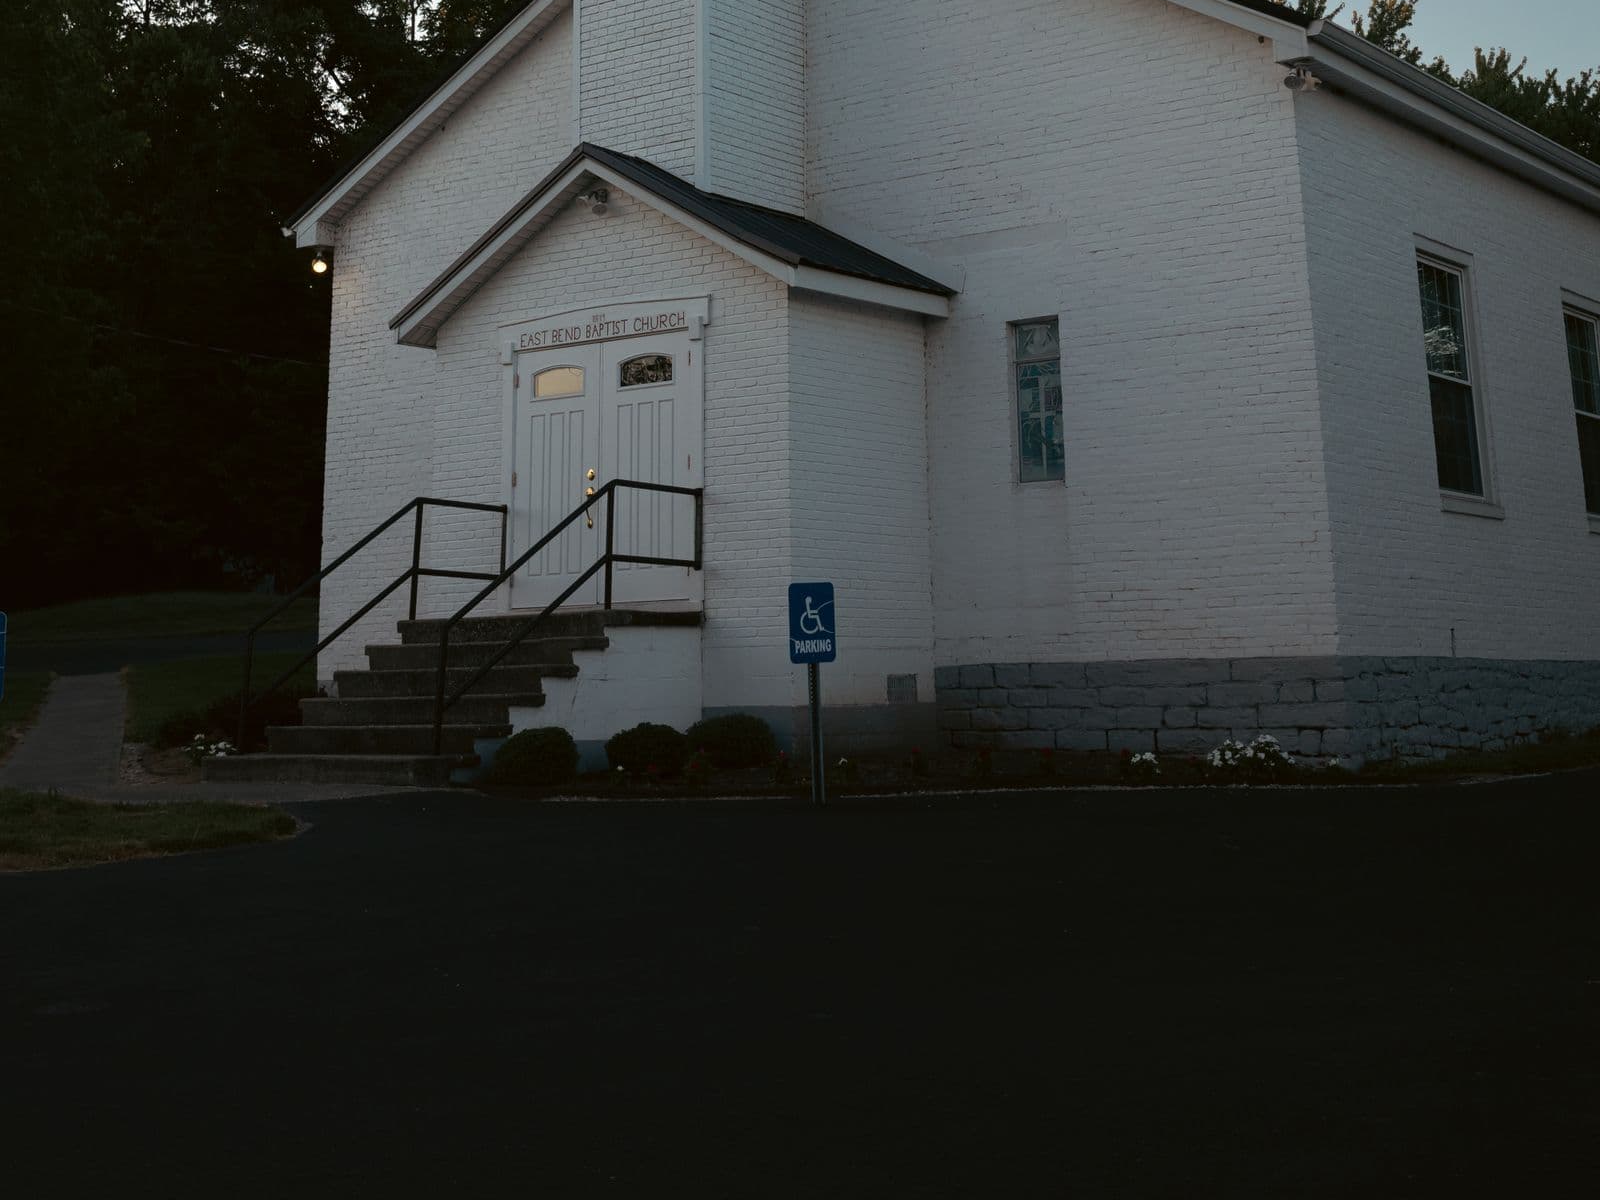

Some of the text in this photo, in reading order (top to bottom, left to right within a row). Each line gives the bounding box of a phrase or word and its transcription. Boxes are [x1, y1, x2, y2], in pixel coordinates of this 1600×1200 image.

[520, 311, 685, 347] EAST BEND BAPTIST CHURCH
[794, 638, 832, 654] PARKING
